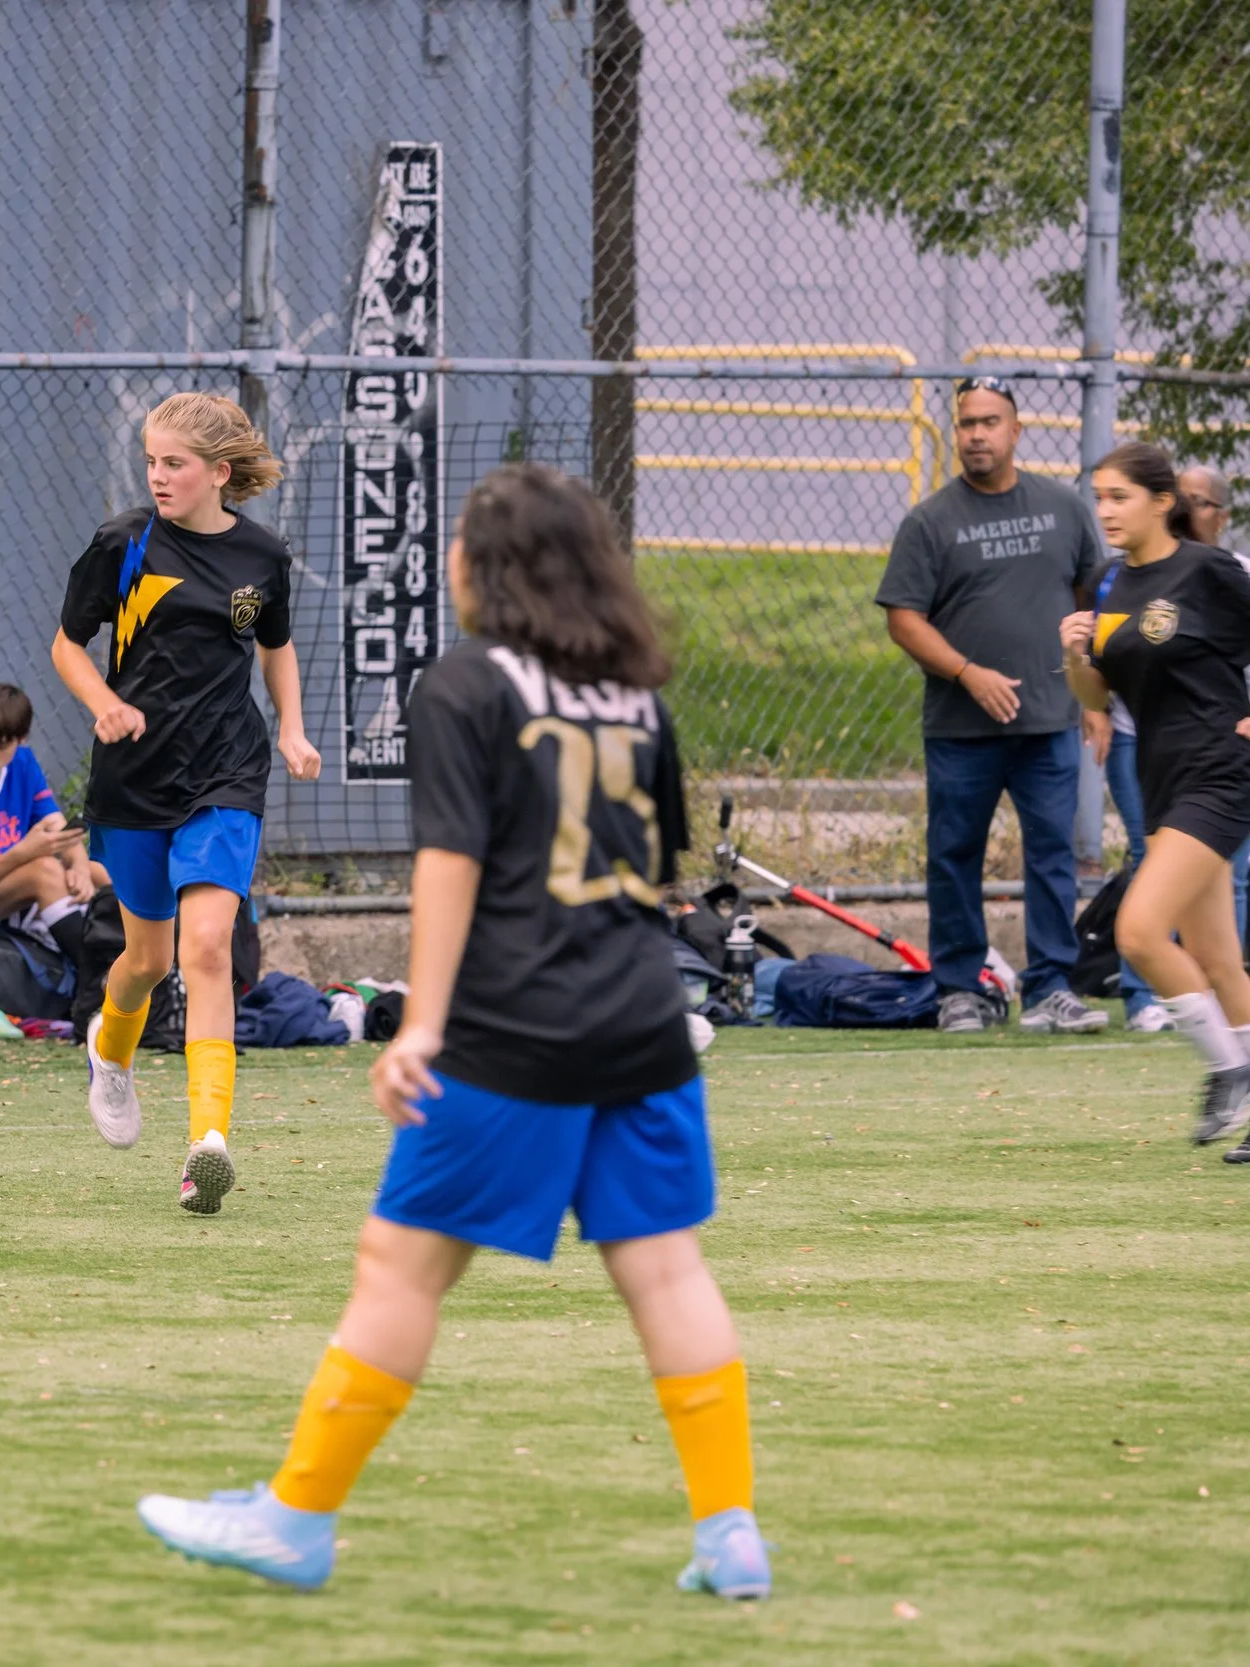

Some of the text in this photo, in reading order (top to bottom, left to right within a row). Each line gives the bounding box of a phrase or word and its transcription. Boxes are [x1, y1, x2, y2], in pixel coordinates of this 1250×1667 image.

[956, 514, 1056, 545] AMERICAN
[980, 535, 1042, 560] EAGLE
[517, 716, 661, 907] 25
